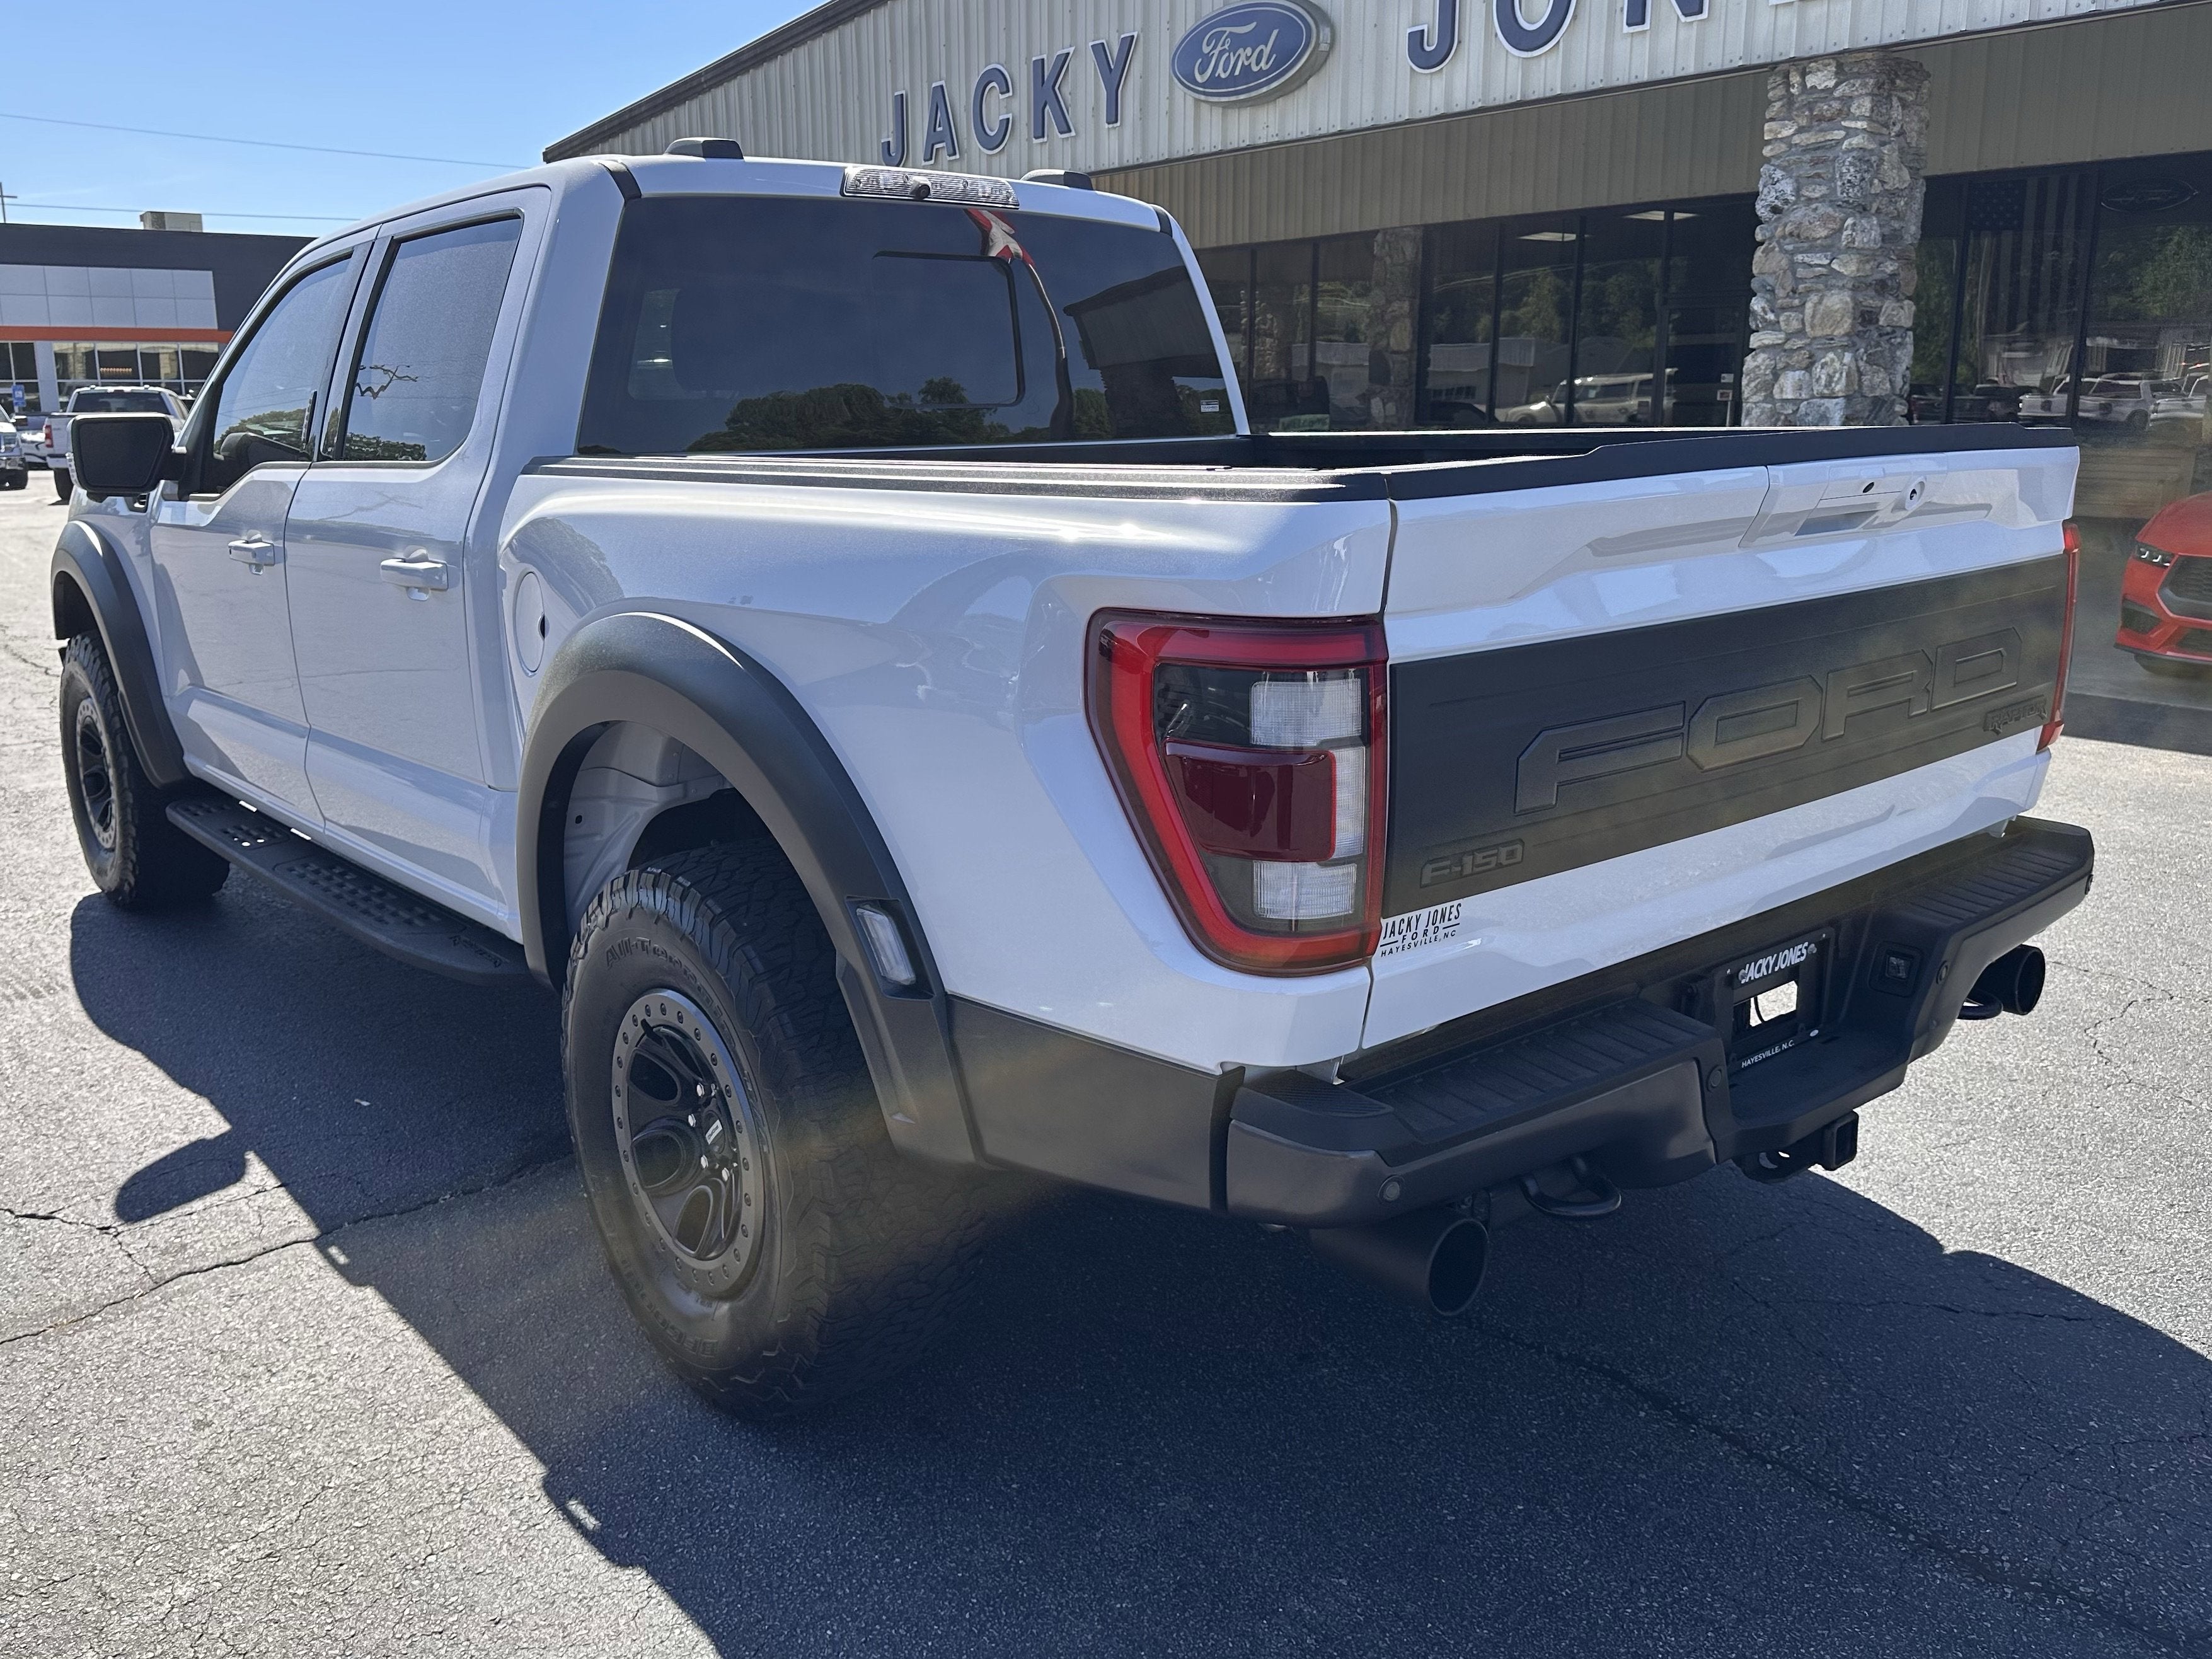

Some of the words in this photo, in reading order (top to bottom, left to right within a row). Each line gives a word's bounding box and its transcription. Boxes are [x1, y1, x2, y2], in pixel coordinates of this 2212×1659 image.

[1194, 21, 1279, 85] Ford
[880, 31, 1139, 168] JACKY
[1514, 627, 2022, 815] FORD
[1983, 694, 2047, 735] RAPTOR
[1420, 840, 1524, 887] F-150
[1383, 914, 1422, 940] JACKY
[1426, 903, 1461, 928] JONES
[1402, 926, 1439, 944] FORD
[1381, 935, 1442, 957] HAYESVILLE,
[1443, 930, 1456, 939] NC
[1741, 955, 1777, 984] JACKY
[1774, 942, 1808, 972] JONES
